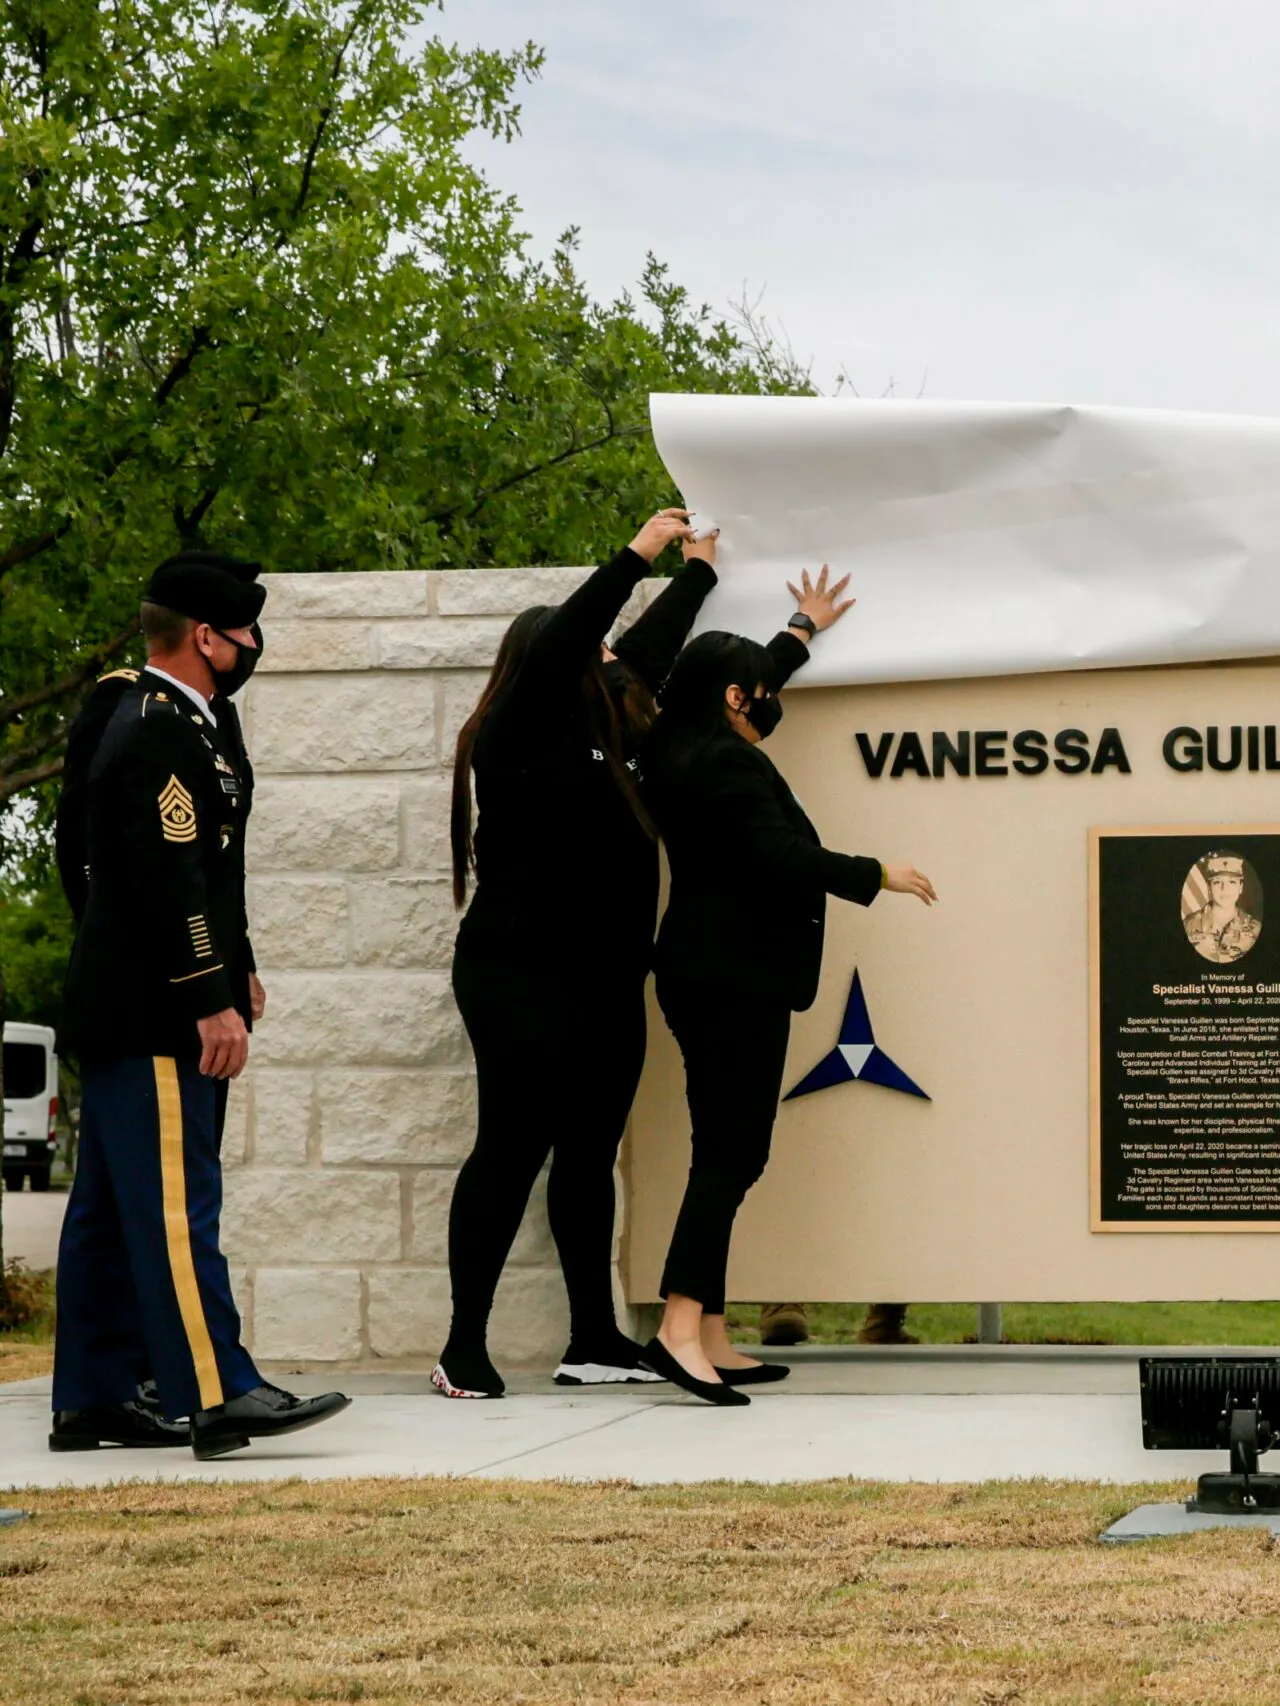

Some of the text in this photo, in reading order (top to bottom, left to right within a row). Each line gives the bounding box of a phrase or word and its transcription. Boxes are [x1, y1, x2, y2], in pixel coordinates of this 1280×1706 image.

[855, 728, 1132, 779] VANESSA
[1153, 984, 1205, 995] Specialist
[1208, 984, 1253, 993] Vanessa
[1229, 1050, 1255, 1058] Training
[1232, 1059, 1258, 1067] Training
[1169, 1093, 1200, 1101] Specialist
[1227, 1152, 1259, 1160] significant
[1148, 1168, 1179, 1176] Specialist
